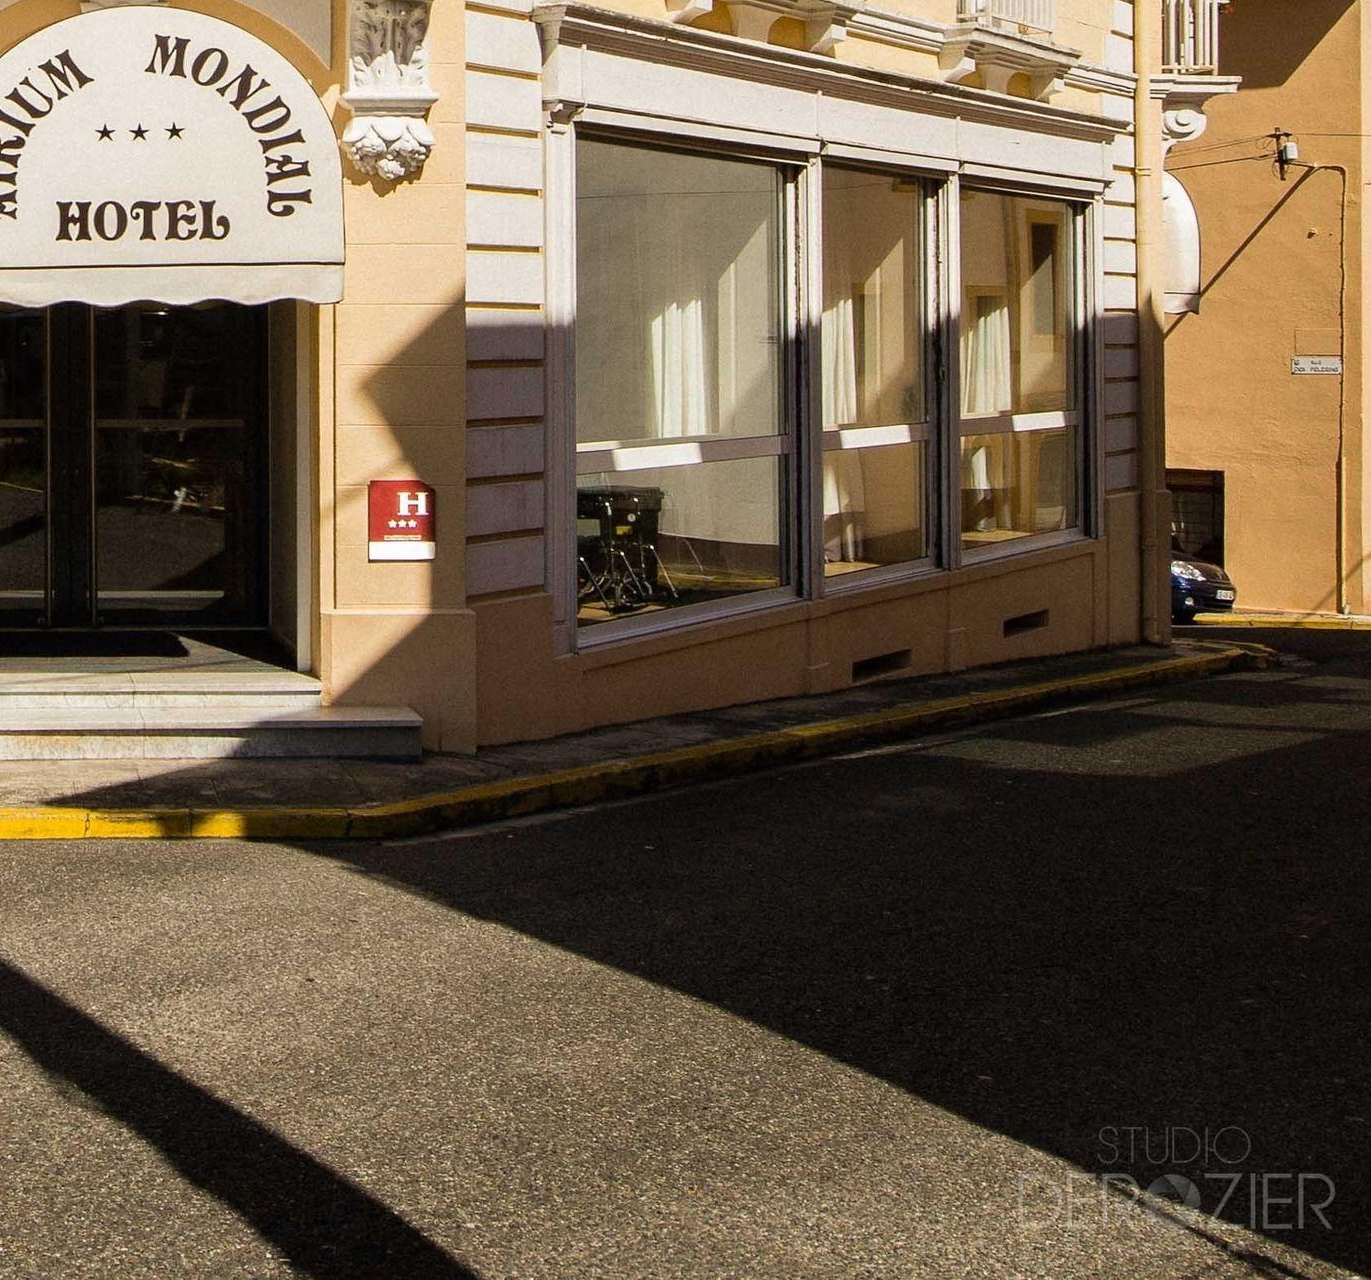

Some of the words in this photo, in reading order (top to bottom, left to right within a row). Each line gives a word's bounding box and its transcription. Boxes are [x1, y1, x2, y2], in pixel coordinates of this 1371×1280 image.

[144, 33, 314, 218] MONDIAL
[55, 199, 231, 242] HOTEL
[396, 491, 430, 516] H
